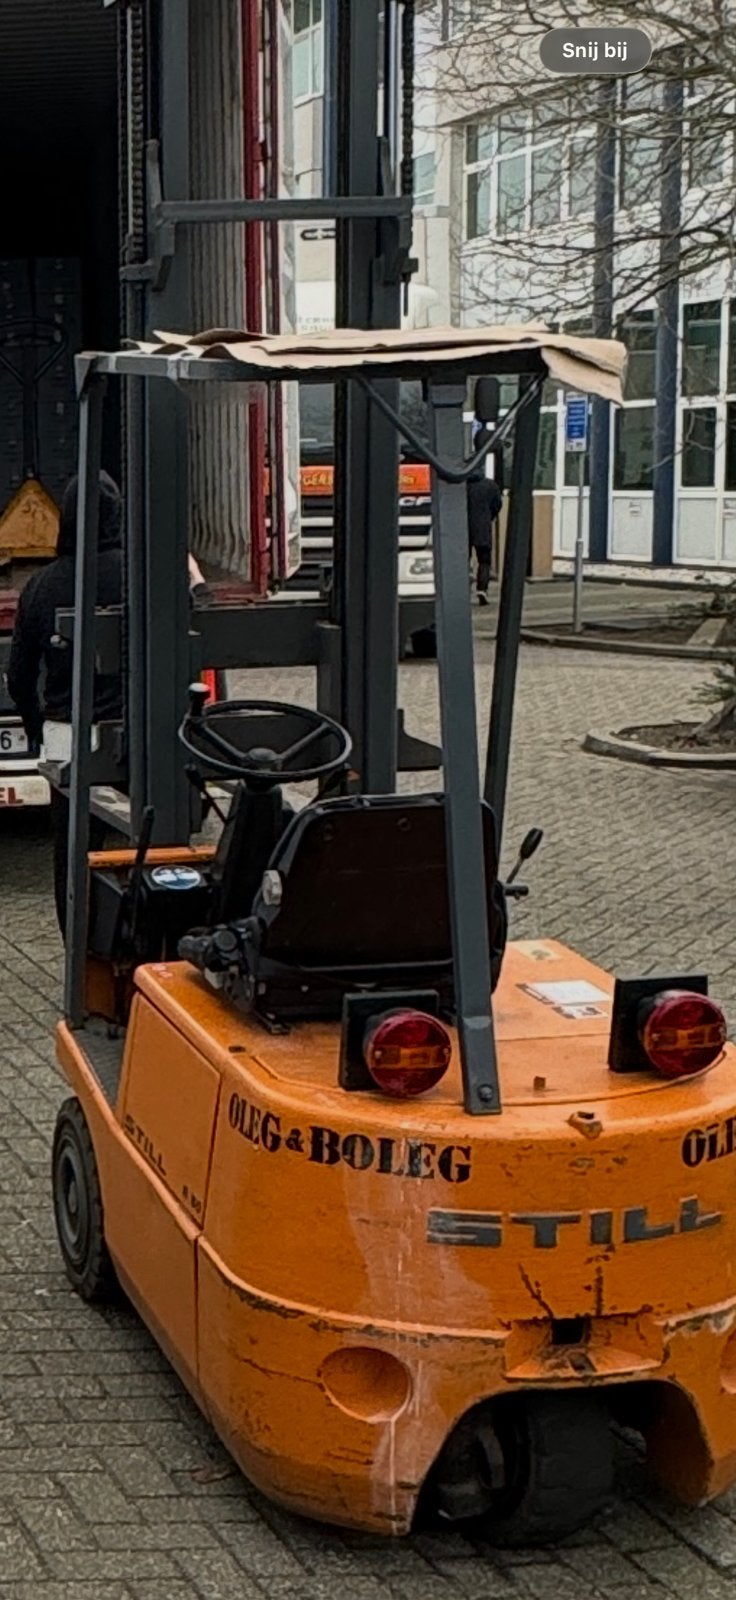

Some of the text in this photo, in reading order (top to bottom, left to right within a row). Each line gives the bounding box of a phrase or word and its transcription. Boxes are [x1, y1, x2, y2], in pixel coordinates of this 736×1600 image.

[1, 730, 12, 750] 6
[124, 1114, 167, 1176] STILL
[228, 1093, 281, 1152] OLEG
[308, 1125, 472, 1183] BOLEG
[427, 1195, 722, 1248] STILL
